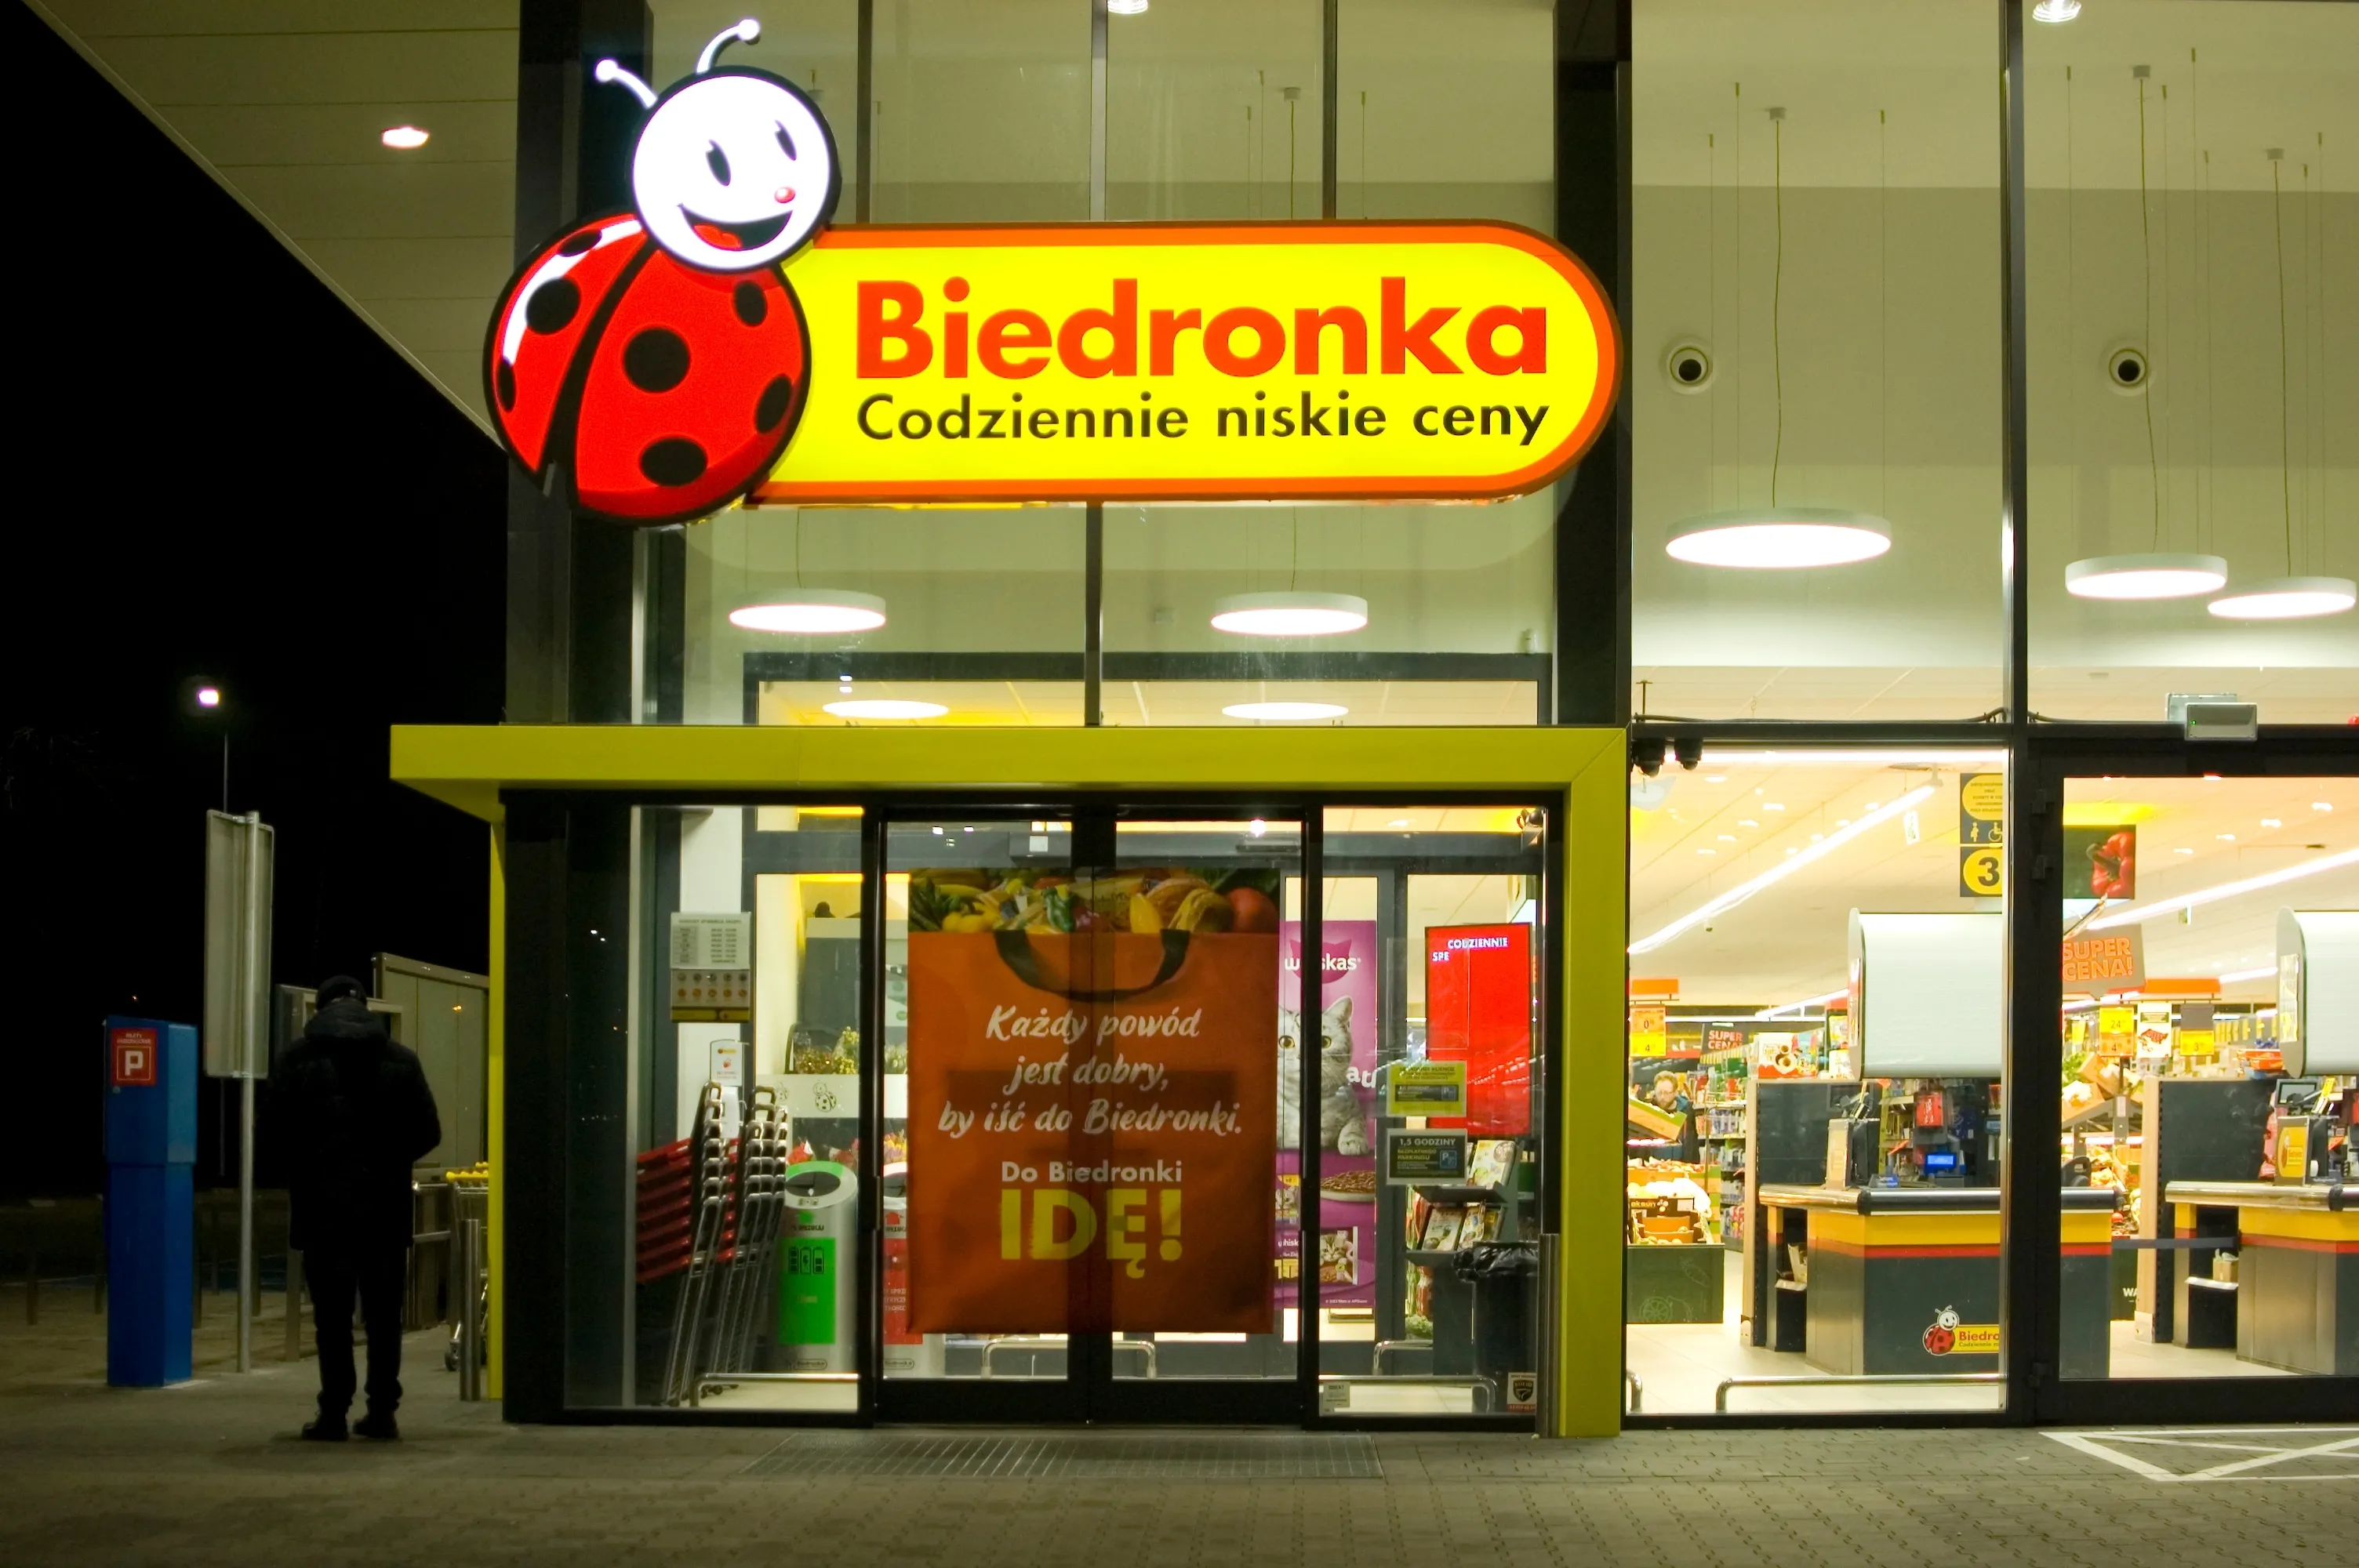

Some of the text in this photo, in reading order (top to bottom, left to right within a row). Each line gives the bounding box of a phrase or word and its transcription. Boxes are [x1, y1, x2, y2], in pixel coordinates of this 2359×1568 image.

[856, 276, 1548, 380] Biedronka
[857, 390, 1551, 447] Codziennie niskie ceny
[1977, 856, 2001, 887] 3
[1285, 953, 1358, 971] wkas
[2063, 937, 2132, 961] SUPER
[2063, 956, 2134, 982] CENA!
[985, 1004, 1203, 1046] Każdy powód
[1708, 1029, 1743, 1042] SUPER
[125, 1051, 144, 1076] P
[1002, 1053, 1169, 1096] jest dobry,
[938, 1098, 1242, 1138] by iść do Biedronki.
[1001, 1160, 1183, 1183] Do Biedronki
[1000, 1188, 1183, 1279] IDĘ!
[1958, 1330, 1999, 1341] Biedro
